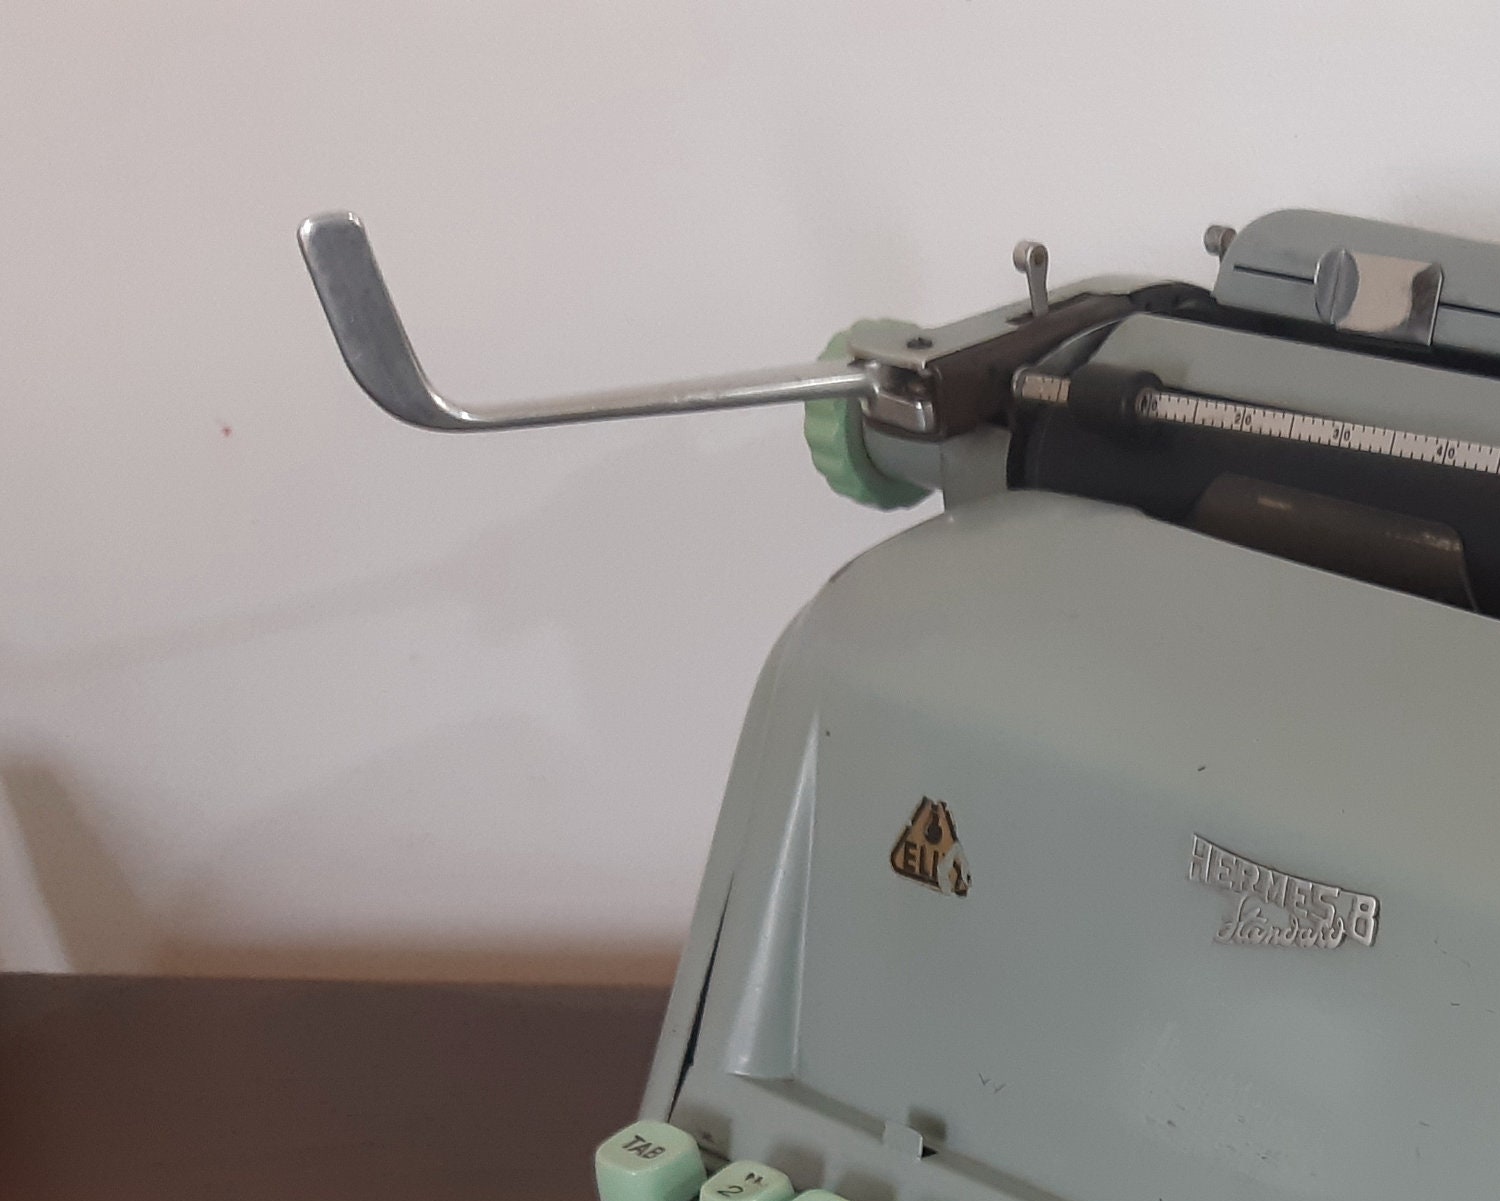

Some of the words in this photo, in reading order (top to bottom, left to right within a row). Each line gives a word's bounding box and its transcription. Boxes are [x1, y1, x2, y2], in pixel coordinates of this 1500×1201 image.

[1234, 414, 1252, 426] 20
[1333, 428, 1351, 442] 30
[1436, 448, 1455, 461] 40
[1188, 834, 1341, 928] HERMES
[1216, 894, 1348, 949] Standard
[621, 1135, 666, 1160] TAB
[716, 1185, 744, 1198] 2
